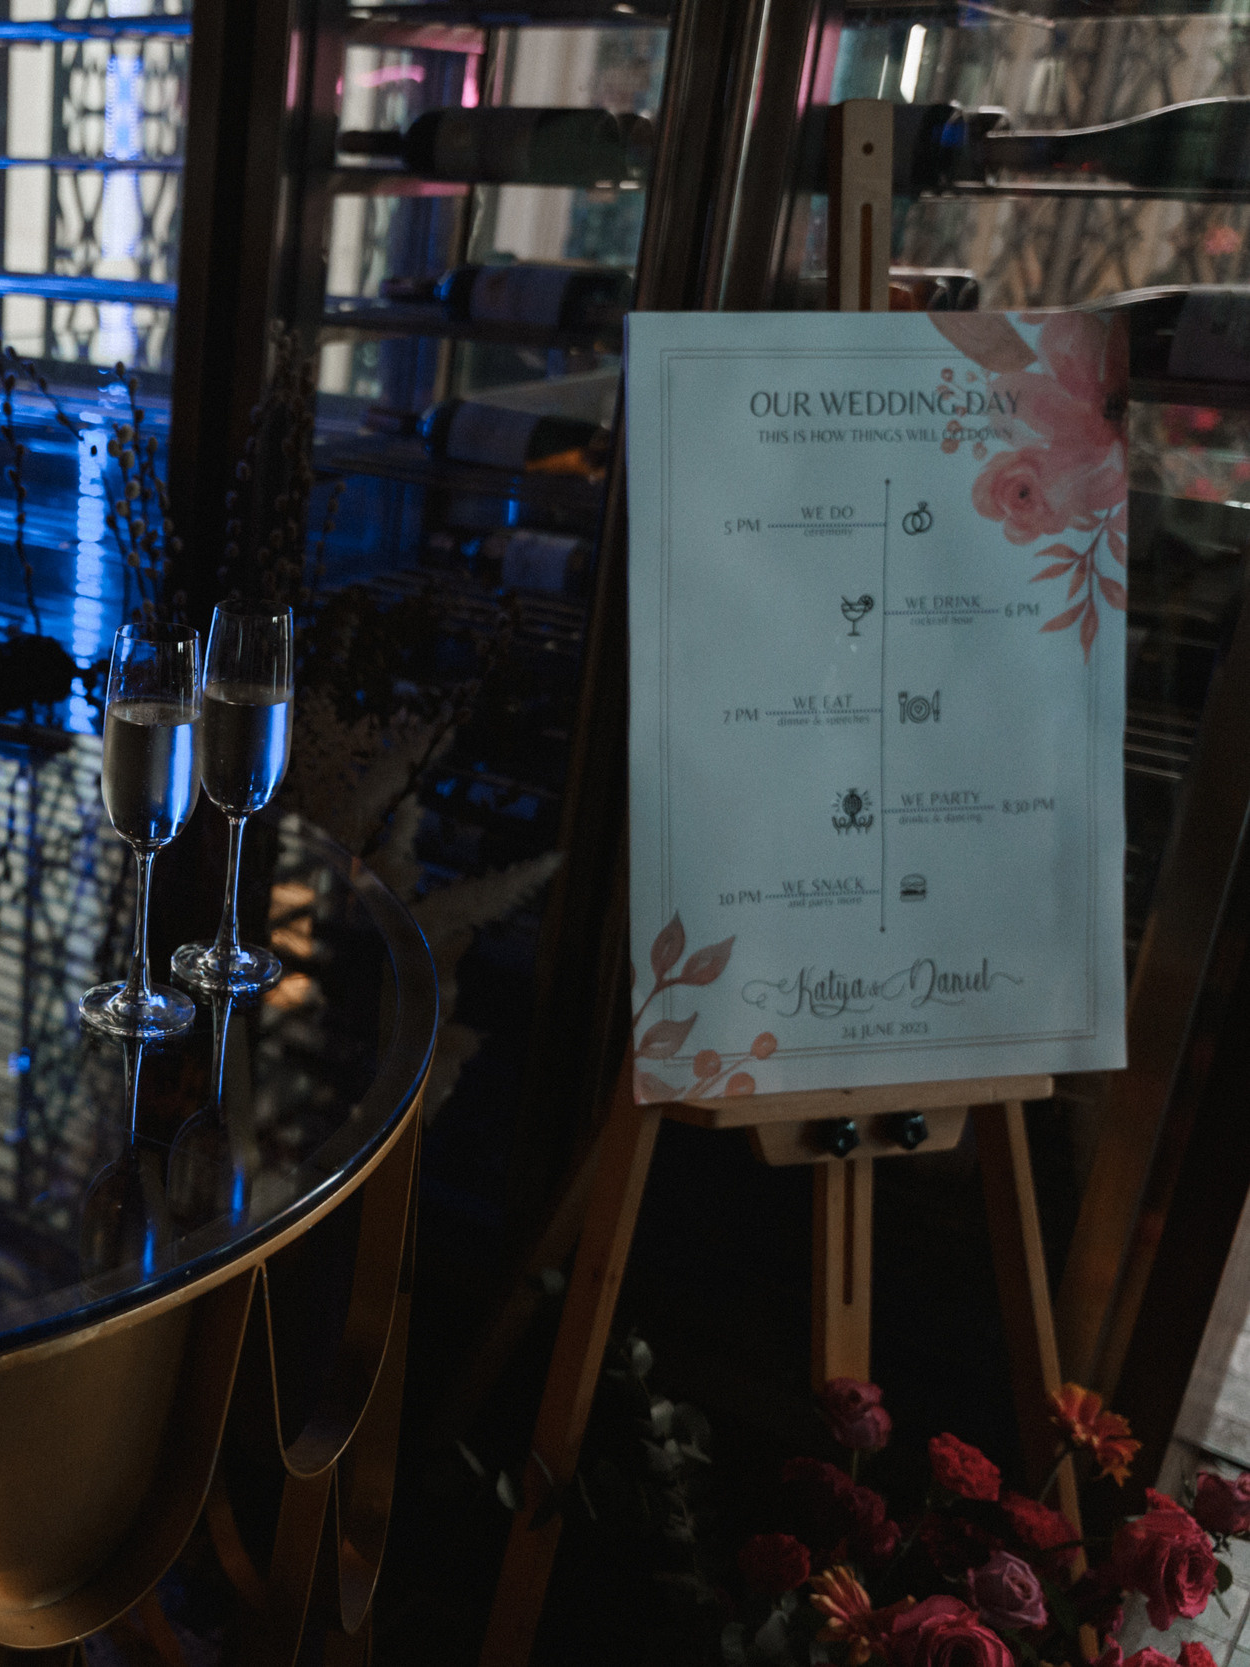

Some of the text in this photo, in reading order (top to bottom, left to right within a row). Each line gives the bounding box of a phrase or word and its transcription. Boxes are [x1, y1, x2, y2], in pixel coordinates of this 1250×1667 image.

[750, 389, 1020, 418] OUR WEDDING DAY
[758, 426, 1012, 444] THIS IS HOW THINGS WILL GO DOWN
[801, 505, 854, 520] WE DO
[724, 518, 761, 535] 5 PM
[803, 528, 853, 537] ceremony
[904, 594, 981, 609] WE DRINK
[1004, 602, 1040, 618] 6 PM
[793, 694, 852, 710] WE EAT
[723, 708, 759, 724] 7 PM
[901, 790, 980, 807] WE PARTY
[1033, 798, 1054, 811] PM
[782, 876, 865, 894] WE SNACK
[718, 890, 761, 907] 10 PM
[744, 964, 870, 1018] Katya
[882, 957, 1022, 1008] Daniel
[842, 1023, 857, 1039] 24
[861, 1021, 893, 1040] JUNE
